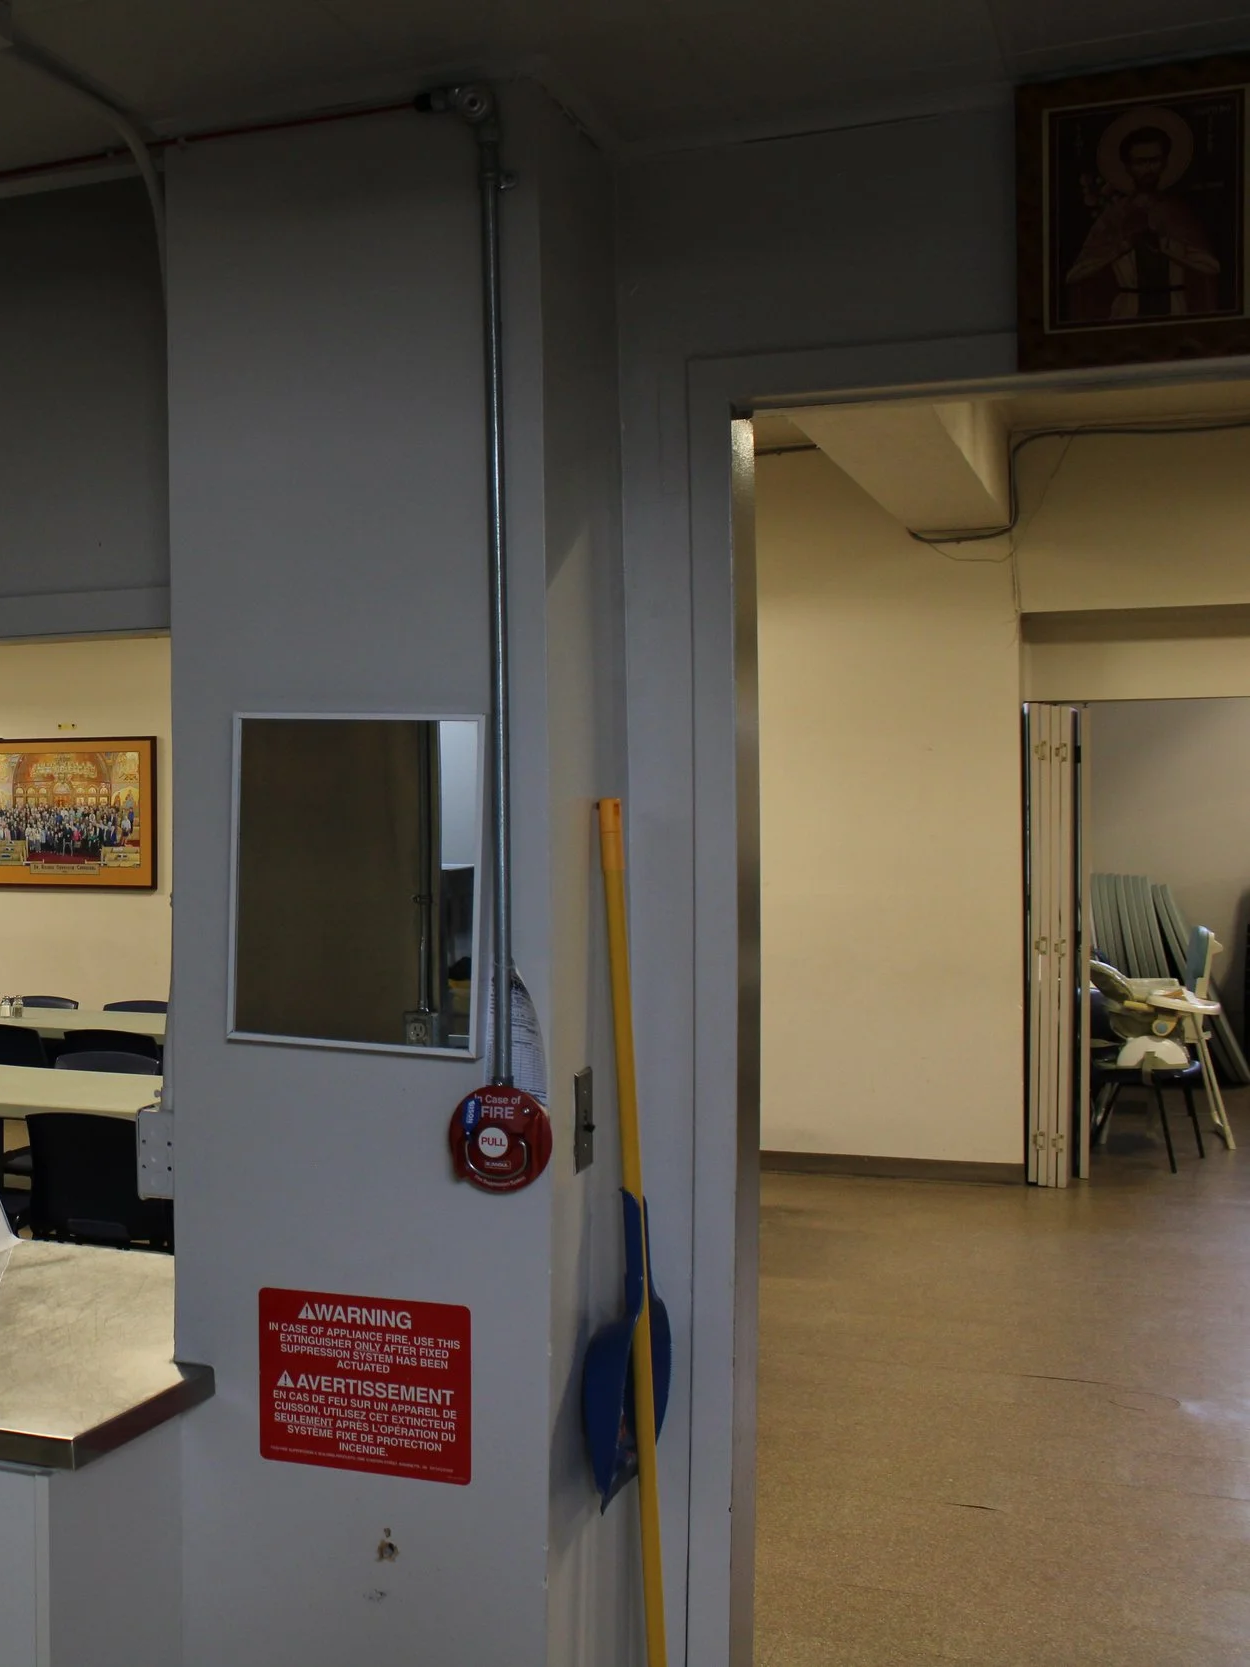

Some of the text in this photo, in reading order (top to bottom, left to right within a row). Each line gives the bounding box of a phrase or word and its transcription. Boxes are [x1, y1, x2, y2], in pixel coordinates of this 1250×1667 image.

[481, 1105, 515, 1120] FIRE
[485, 1094, 509, 1104] Case
[511, 1095, 521, 1105] of
[481, 1136, 506, 1147] PULL
[314, 1303, 412, 1330] WARNING
[269, 1321, 460, 1350] IN CASE OF APPLIANCE FIRE, USE THIS
[279, 1334, 449, 1359] EXTINGUISHER ONLY AFTER FIXED
[280, 1344, 448, 1370] SUPPRESSION SYSTEM HAS BEEN
[336, 1360, 390, 1374] ACTUATED
[296, 1373, 454, 1406] AVERTISSEMENT
[273, 1389, 457, 1420] EN CAS DE FEU SUR UN APPAREIL DE
[274, 1401, 455, 1431] CUISSON, UTILISEZ CET EXTINCTEUR
[274, 1411, 456, 1443] SEULEMENT APRÈS L'OPÉRATION DU
[287, 1424, 442, 1452] SYSTÈME FIXE DE PROTECTION
[339, 1442, 388, 1457] INCENDIE.
